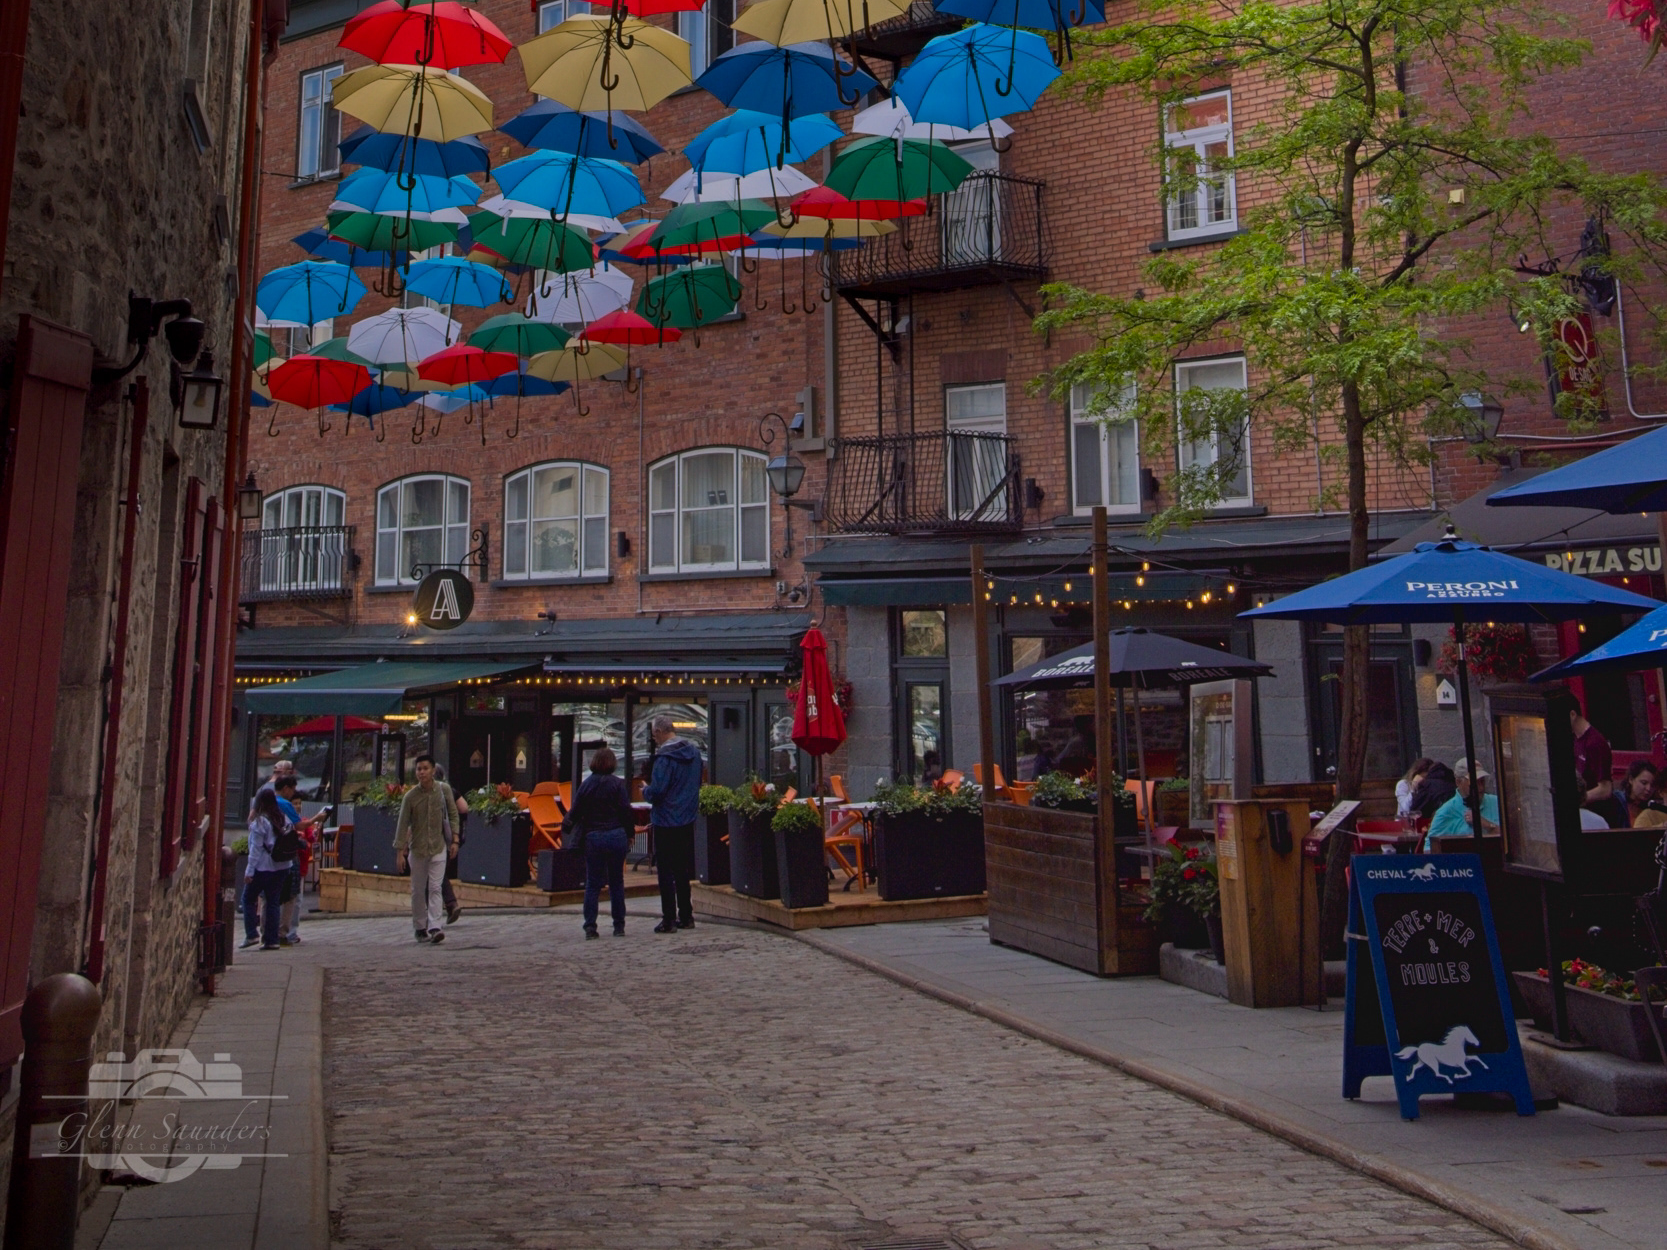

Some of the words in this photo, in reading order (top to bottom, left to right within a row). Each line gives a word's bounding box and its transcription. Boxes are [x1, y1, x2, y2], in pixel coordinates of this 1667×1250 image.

[1545, 548, 1624, 575] PIZZA
[1406, 580, 1520, 592] PERONI
[430, 579, 461, 620] A
[1366, 869, 1407, 880] CHEVAL
[1439, 867, 1474, 879] BLANC
[1382, 909, 1424, 954] TERRE
[1436, 909, 1476, 948] MER
[1429, 937, 1440, 955] &
[1400, 960, 1472, 986] MOULES
